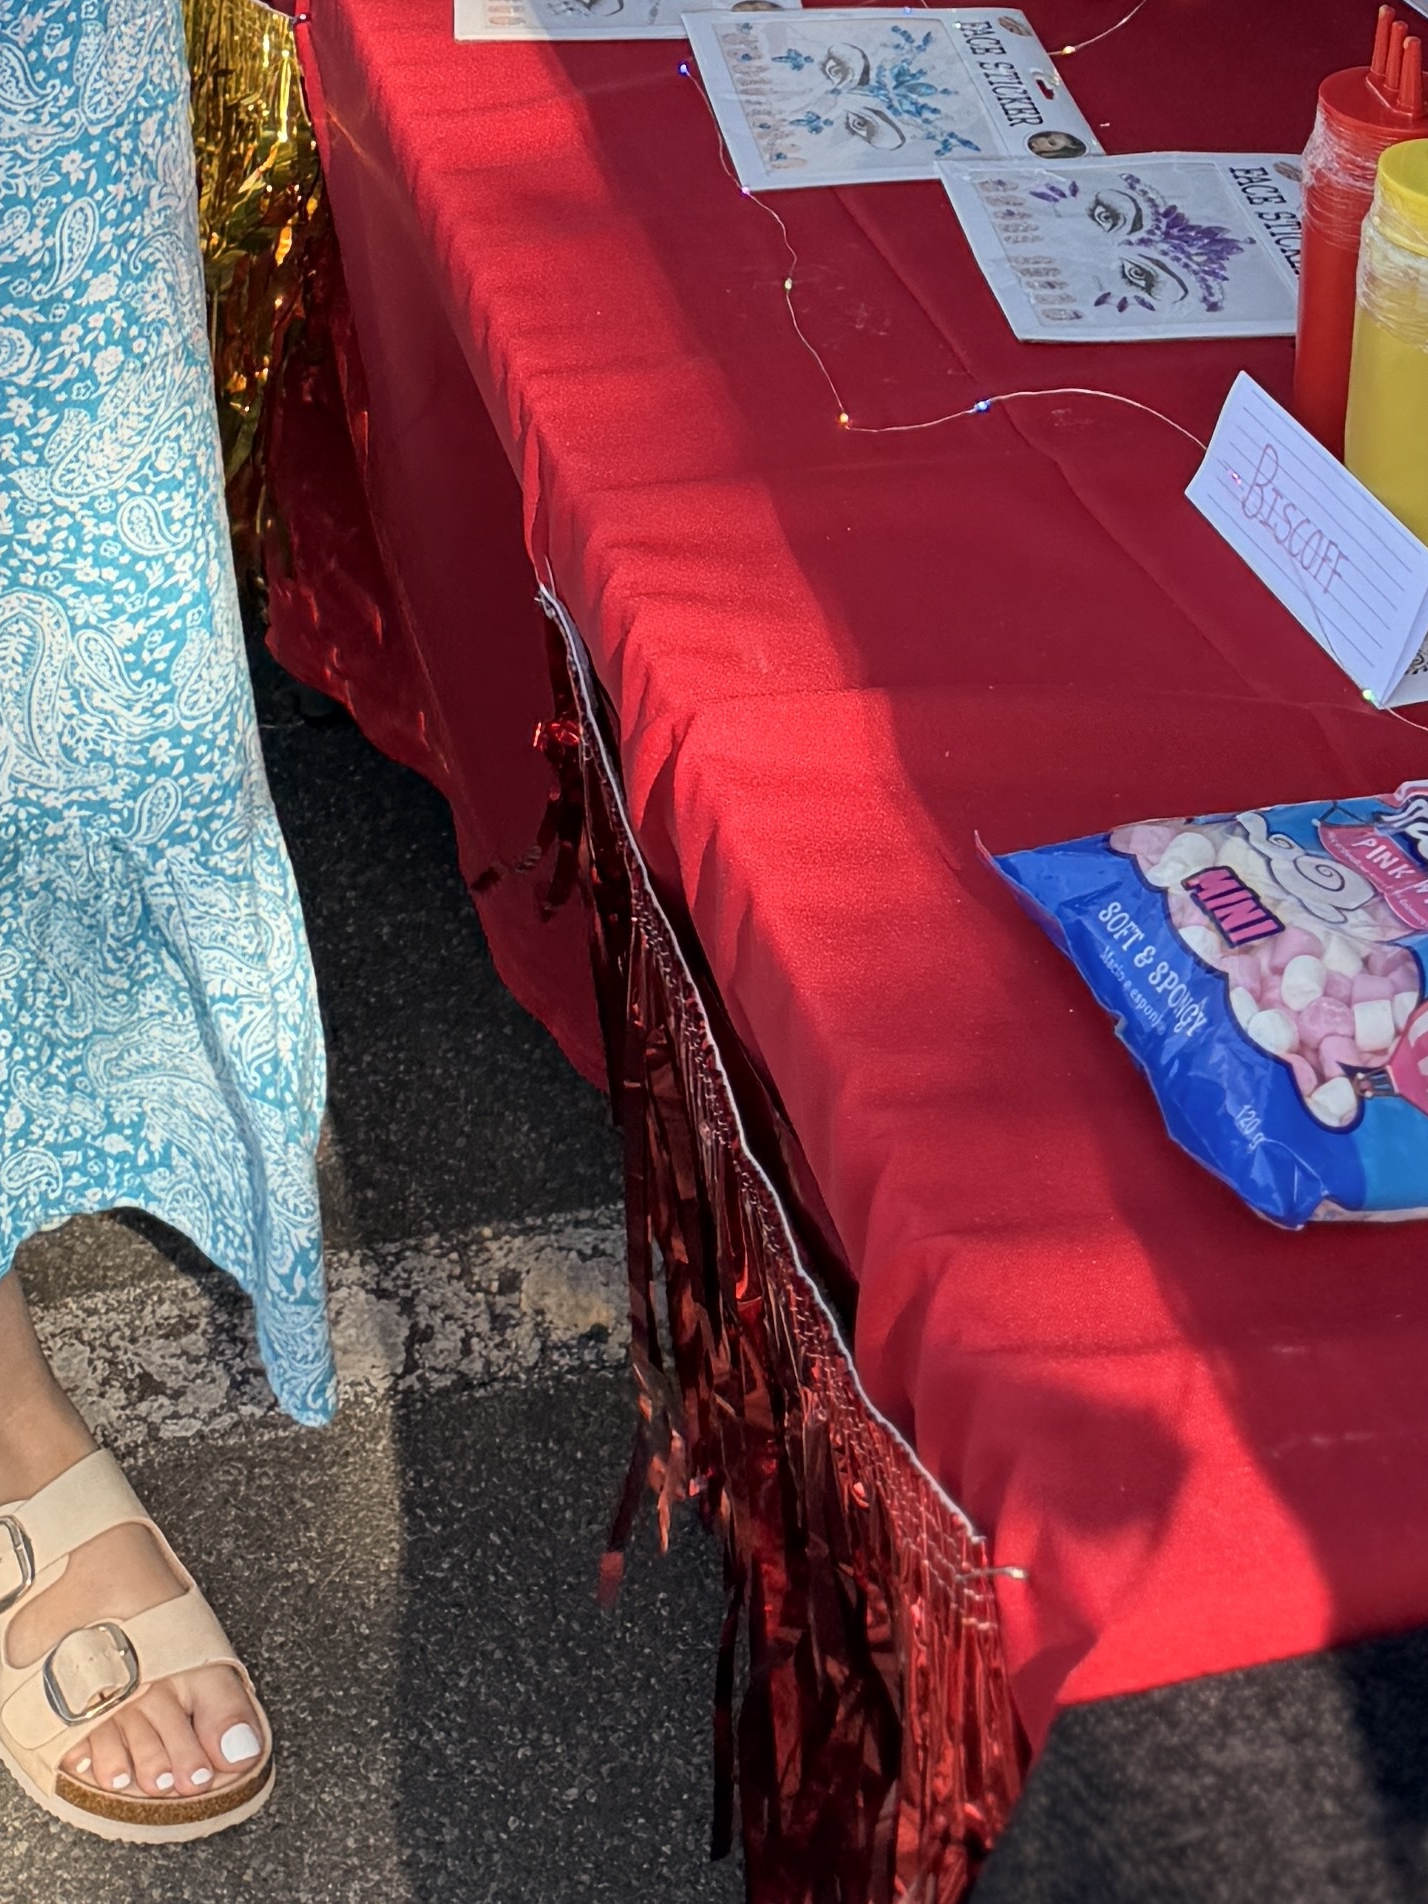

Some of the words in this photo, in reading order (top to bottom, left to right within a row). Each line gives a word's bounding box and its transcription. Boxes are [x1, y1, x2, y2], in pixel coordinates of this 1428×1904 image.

[955, 20, 1007, 55] FACE
[975, 60, 1044, 128] STICKER
[1228, 166, 1288, 206] FACE
[1351, 836, 1416, 880] PINK
[1183, 867, 1283, 945] MINI
[1098, 901, 1145, 952] SOFT
[1133, 944, 1157, 969] &
[1147, 960, 1208, 1038] SPONGY
